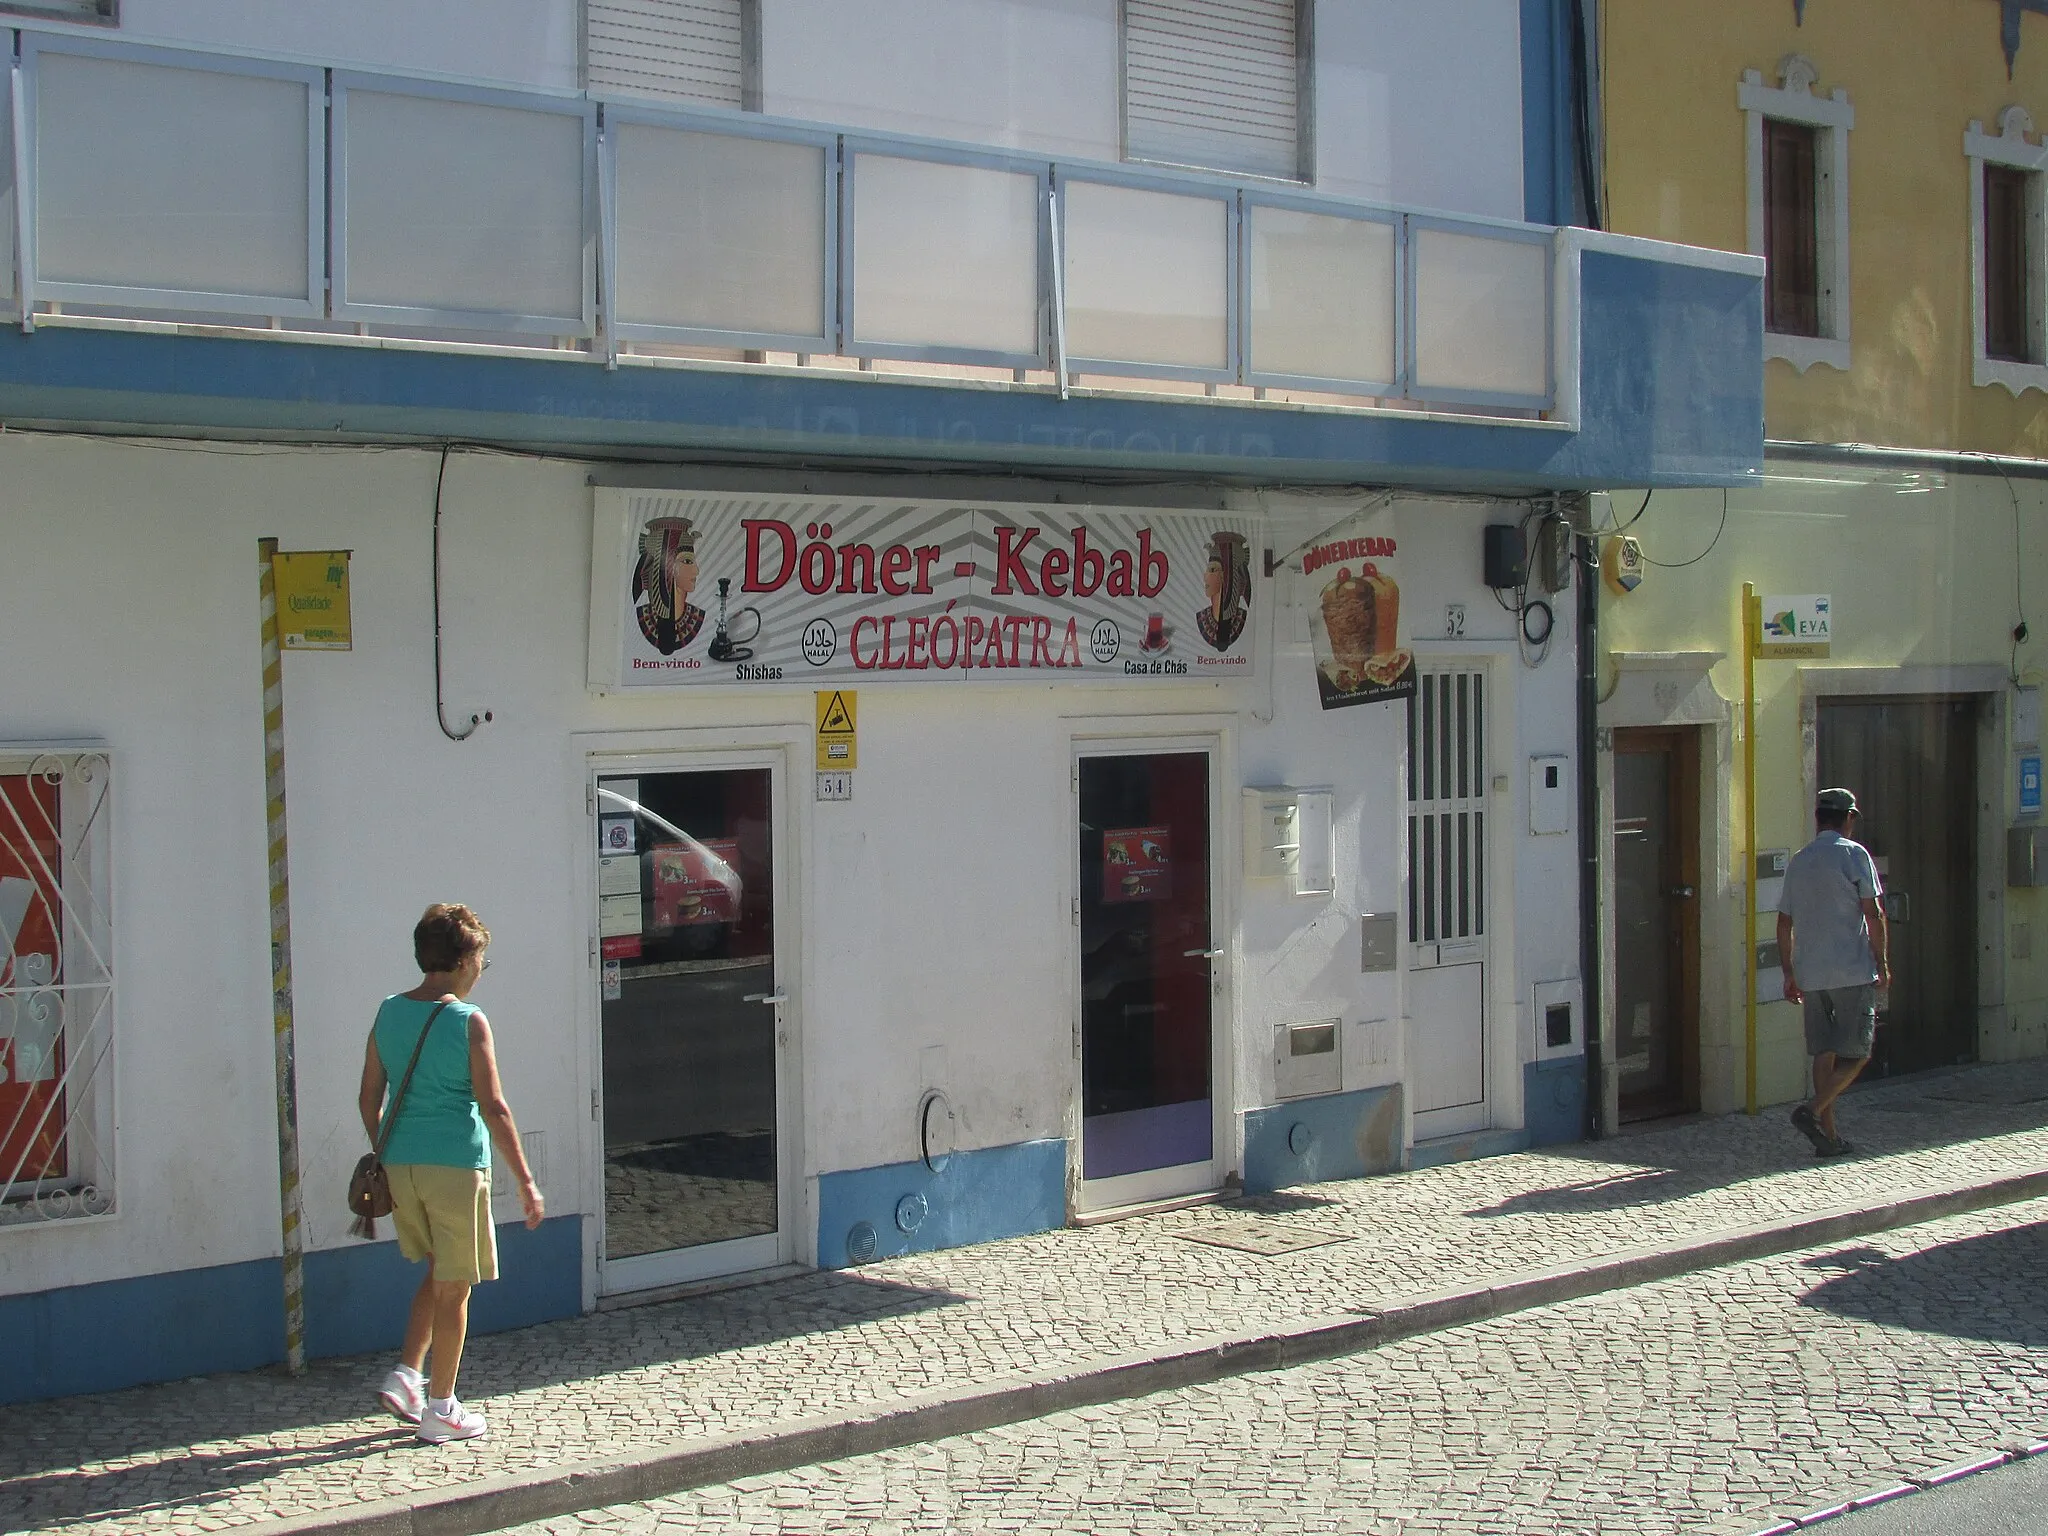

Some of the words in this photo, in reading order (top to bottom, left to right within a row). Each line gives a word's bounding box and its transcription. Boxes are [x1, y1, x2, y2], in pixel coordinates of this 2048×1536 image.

[741, 519, 940, 596] Döner
[954, 562, 976, 577] -
[991, 526, 1169, 598] Kebab
[1447, 610, 1464, 635] 52
[1800, 620, 1828, 633] EVA
[805, 628, 833, 647] حلال
[850, 599, 1083, 670] CLEÓPATRA
[1093, 628, 1117, 646] حلال
[632, 658, 701, 669] Bem-vindo
[1124, 660, 1148, 674] Casa
[1150, 660, 1162, 674] de
[1164, 658, 1188, 674] Chás
[1197, 656, 1247, 665] Bem-vindo
[736, 664, 783, 681] Shishas
[824, 779, 843, 794] 54
